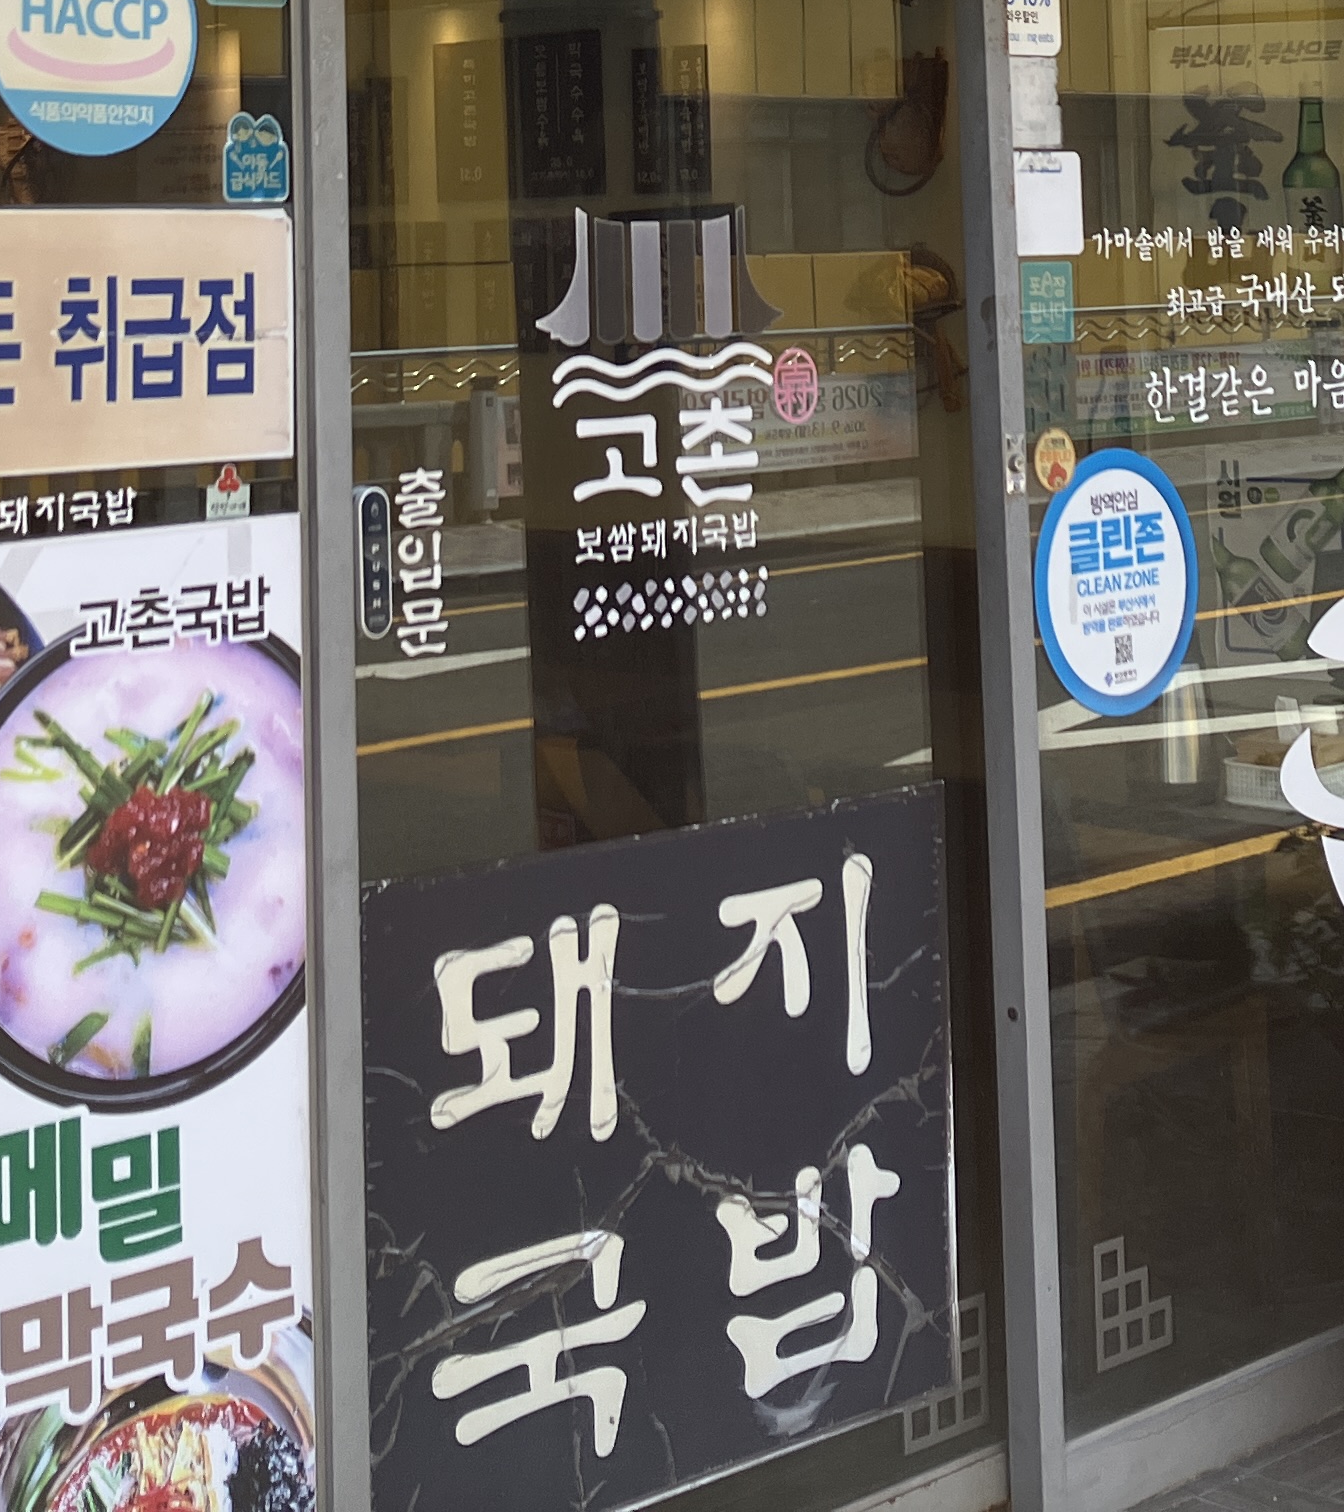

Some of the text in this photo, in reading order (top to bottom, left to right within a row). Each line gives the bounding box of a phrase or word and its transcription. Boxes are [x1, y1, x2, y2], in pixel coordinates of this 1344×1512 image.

[1091, 226, 1194, 262] 가마솥에서
[1207, 224, 1246, 260] 밤을
[1256, 224, 1294, 257] 새워
[1166, 285, 1227, 319] 최고급
[1235, 272, 1317, 317] 국내산
[55, 272, 257, 403] 취급점
[1144, 359, 1276, 424] 한결같은
[573, 397, 760, 507] 고촌
[1089, 488, 1140, 516] 방역안심
[394, 466, 450, 658] 출입문
[574, 508, 760, 564] 보쌈돼지국밥
[1068, 511, 1166, 575] 클린존
[71, 575, 271, 651] 고촌국밥
[1077, 567, 1160, 598] CLEAN ZONE
[430, 852, 875, 1143] 돼지
[430, 1142, 902, 1460] 국밥
